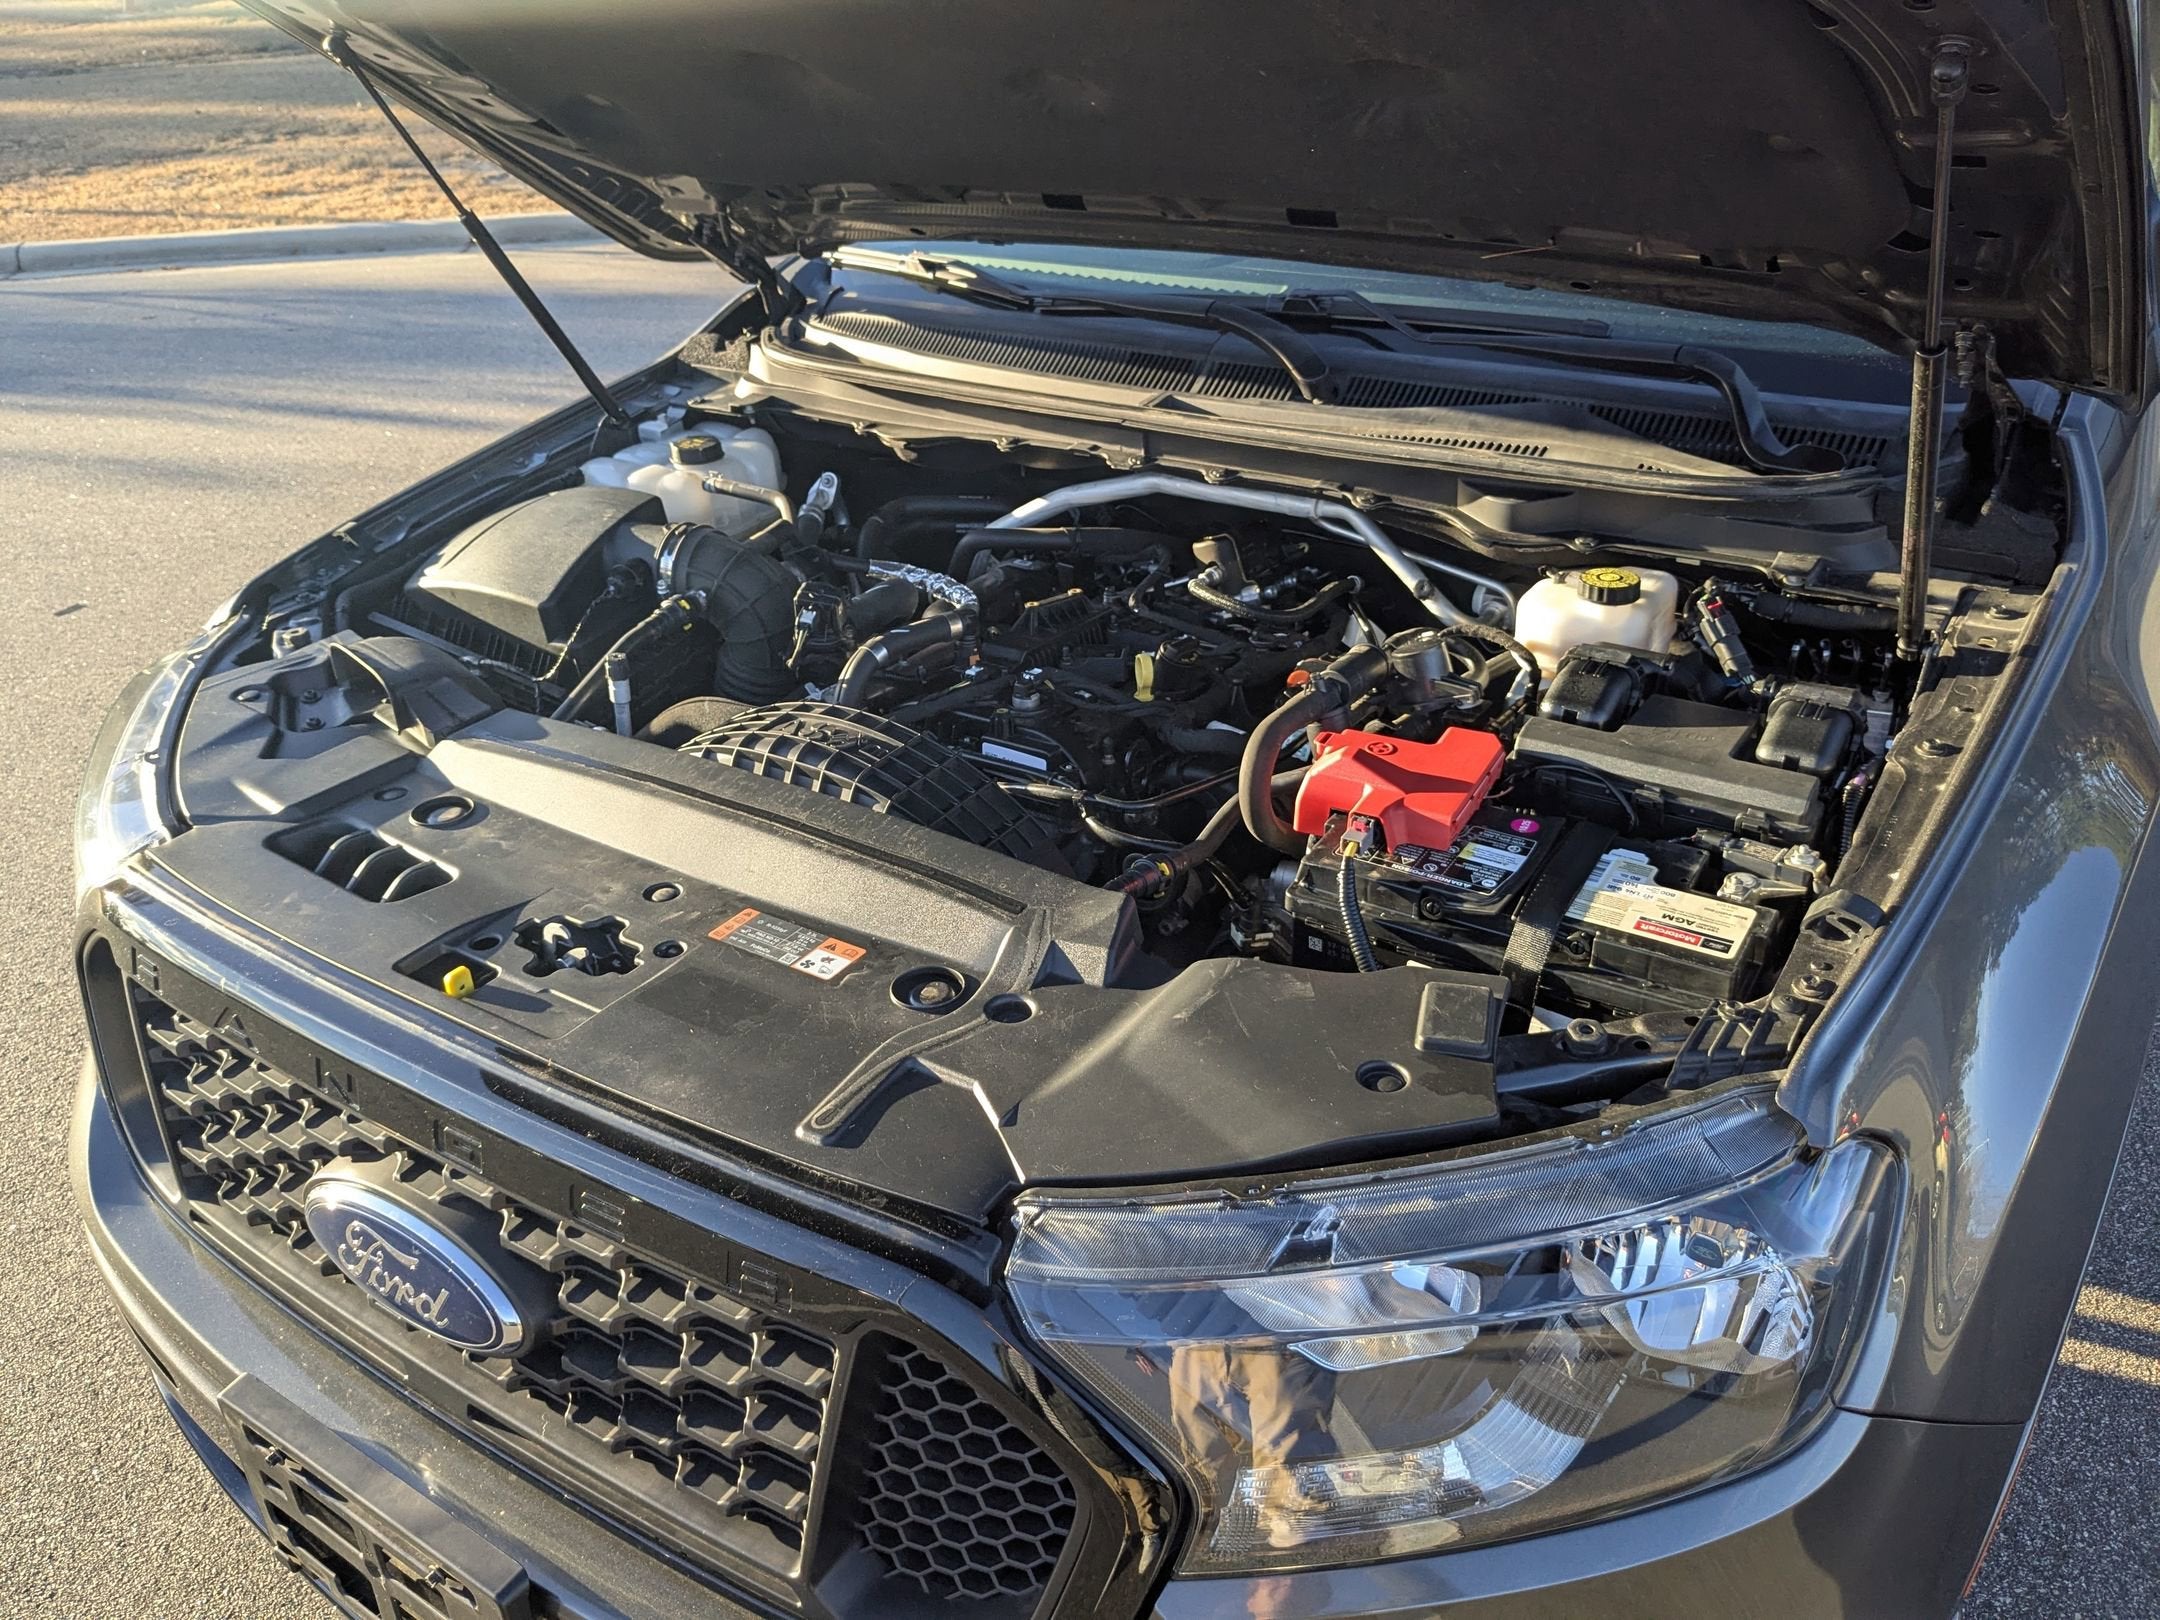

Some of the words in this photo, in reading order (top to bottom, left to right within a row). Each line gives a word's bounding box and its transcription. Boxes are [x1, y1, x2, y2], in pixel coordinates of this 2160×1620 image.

[1661, 913, 1697, 926] AGM
[1640, 923, 1697, 943] Motorcraft
[338, 1220, 450, 1328] Ford
